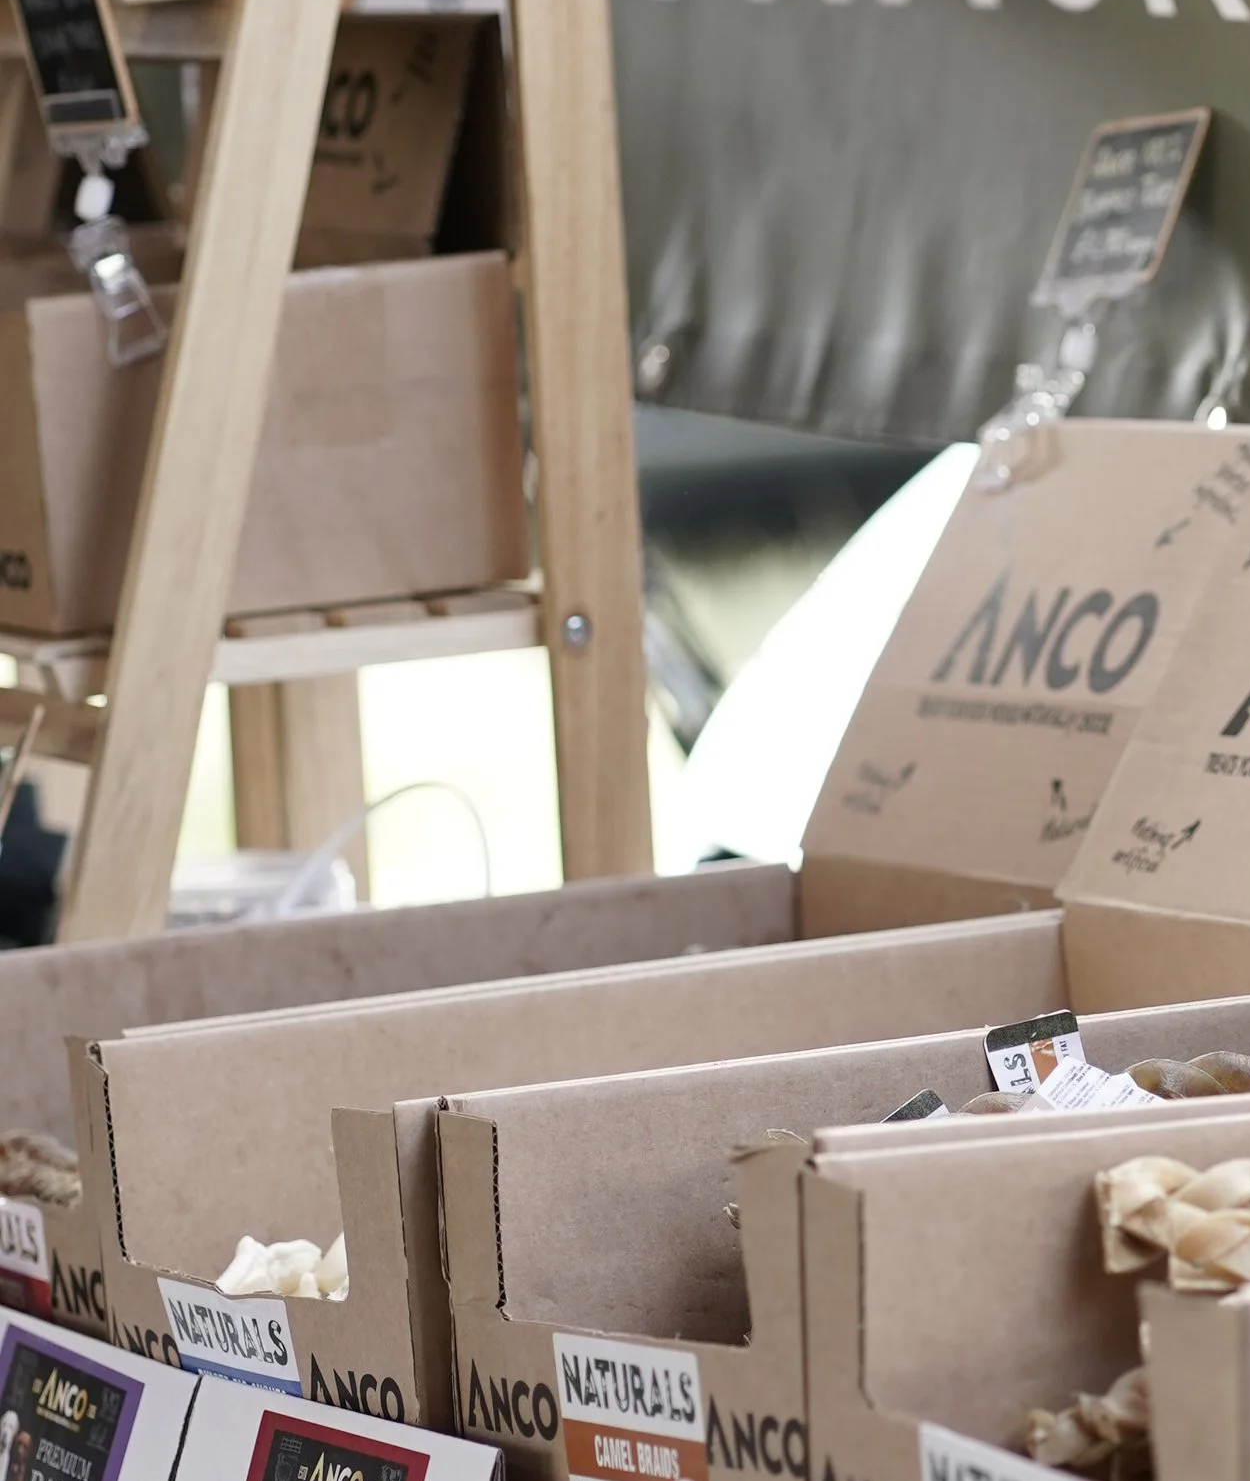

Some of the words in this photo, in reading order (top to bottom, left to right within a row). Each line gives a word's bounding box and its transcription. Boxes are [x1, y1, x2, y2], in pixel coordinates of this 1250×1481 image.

[932, 561, 1159, 694] ANCO
[52, 1247, 105, 1322] ANC
[168, 1297, 289, 1367] NATURALS
[38, 1367, 88, 1421] ANCO
[310, 1351, 406, 1423] ANCO
[467, 1358, 559, 1441] ANCO
[561, 1351, 697, 1425] NATURALS
[593, 1433, 636, 1474] CAMEL
[637, 1441, 681, 1481] BRAIDS
[706, 1394, 807, 1479] ANCO
